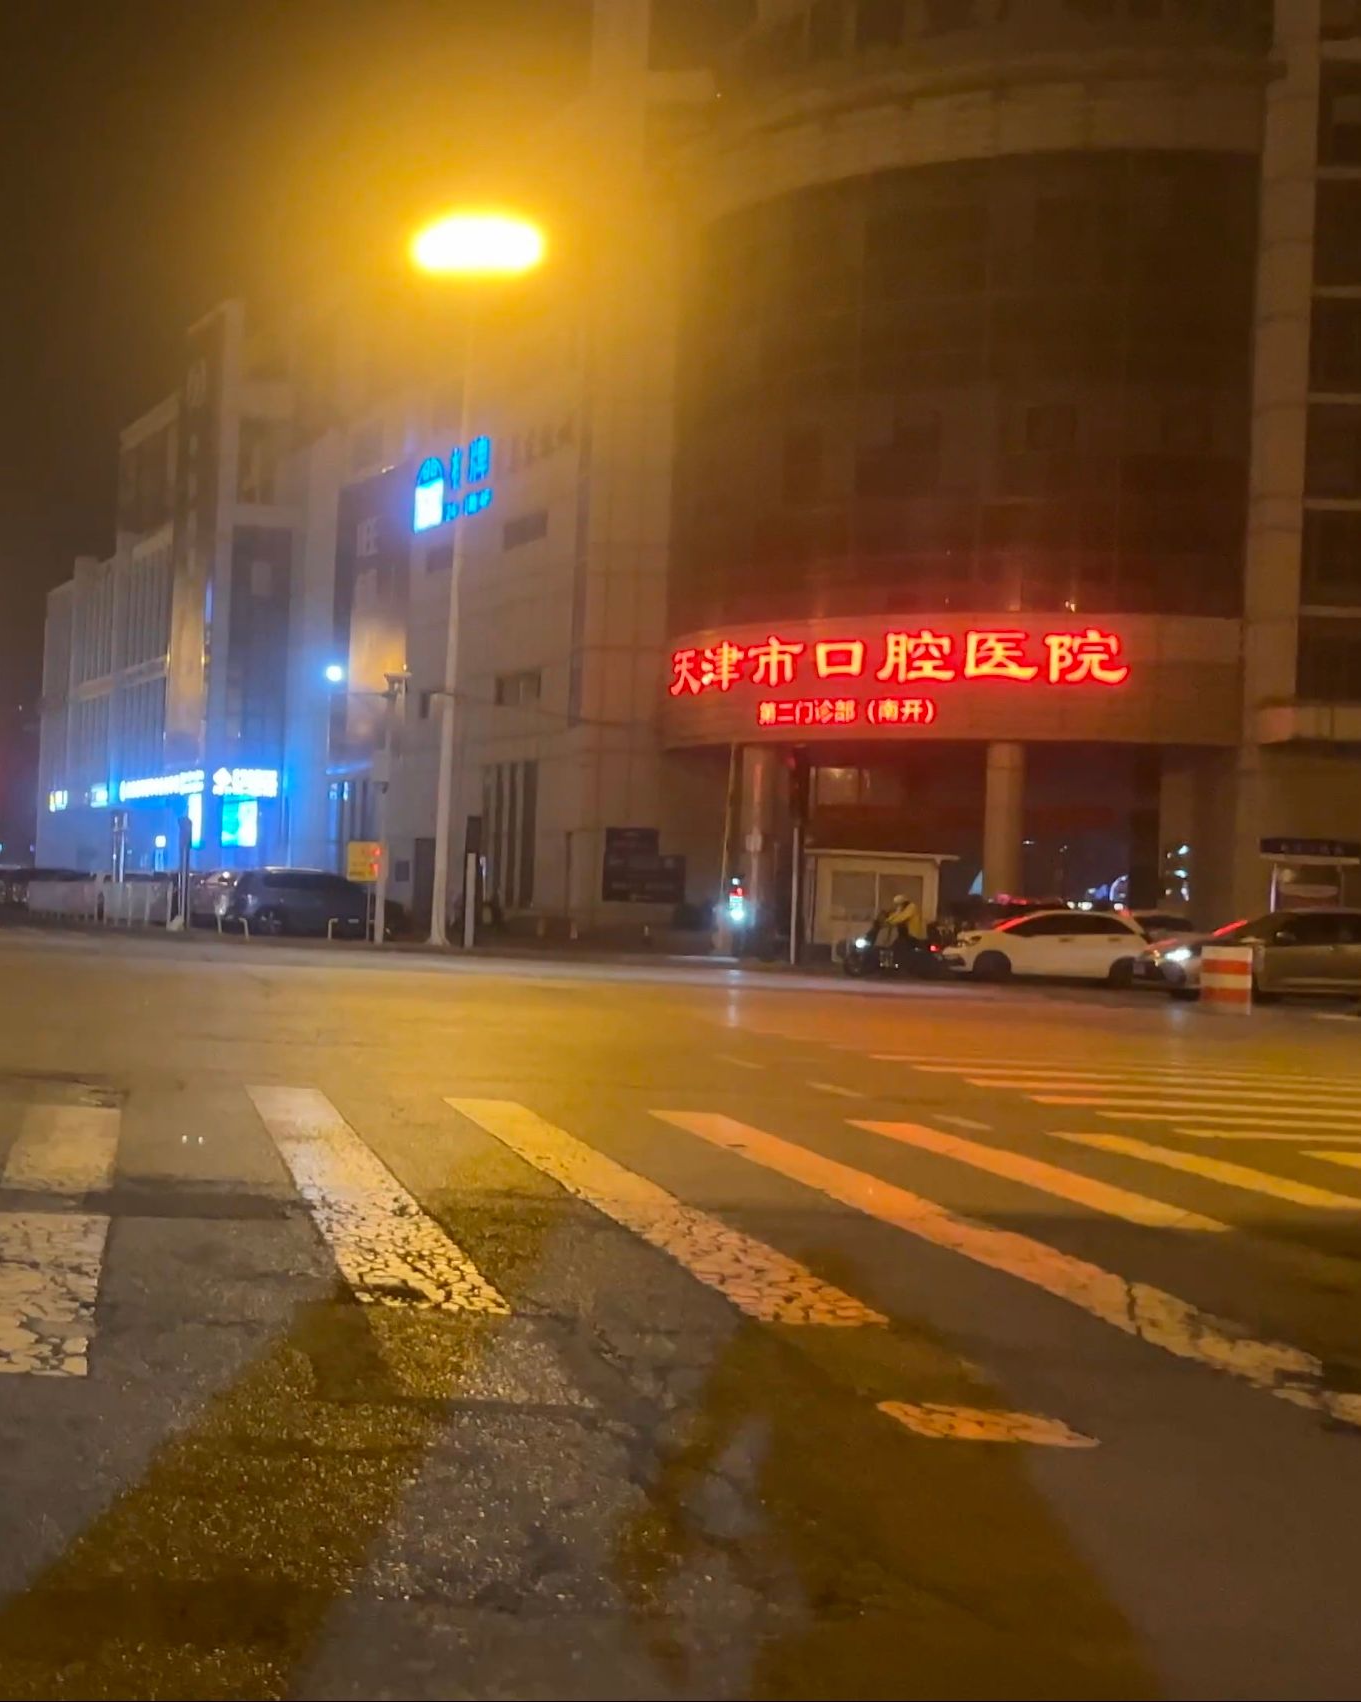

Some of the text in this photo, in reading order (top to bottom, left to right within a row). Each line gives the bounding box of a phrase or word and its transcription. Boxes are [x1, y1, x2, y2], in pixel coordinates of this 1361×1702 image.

[670, 629, 1128, 696] 天津市口腔医院
